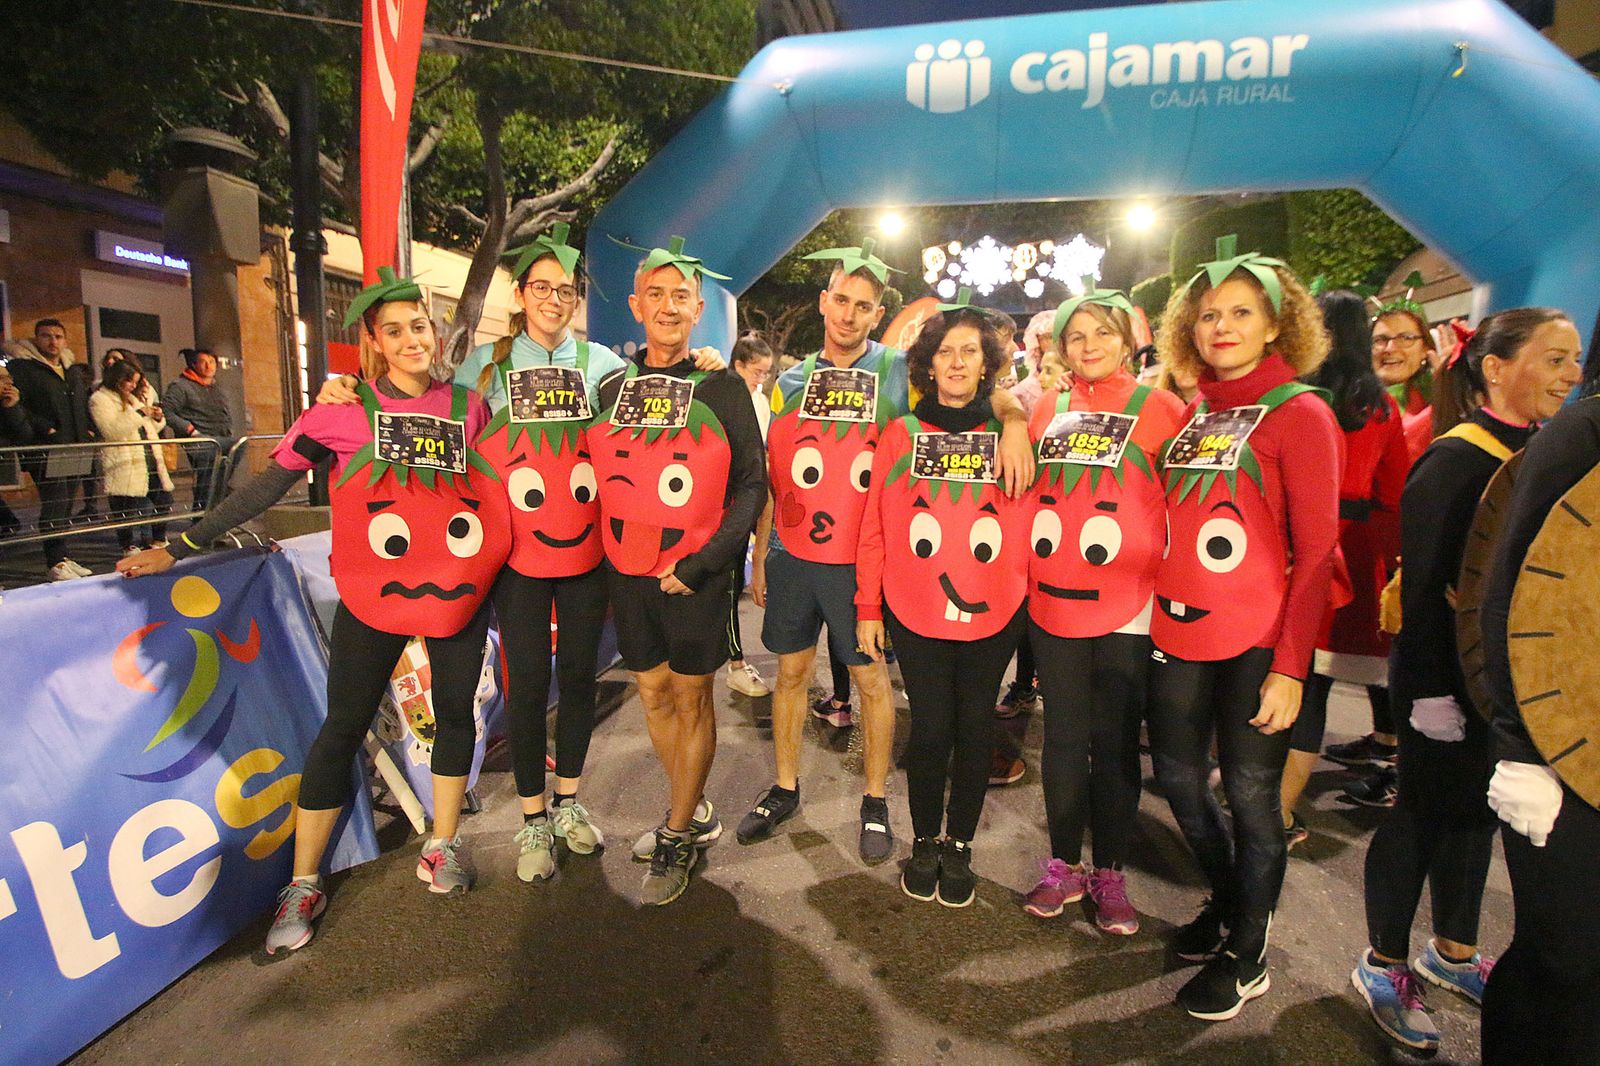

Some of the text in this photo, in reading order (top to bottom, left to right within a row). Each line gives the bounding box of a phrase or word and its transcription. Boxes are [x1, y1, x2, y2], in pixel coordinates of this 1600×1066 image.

[1010, 32, 1309, 109] cajamar
[1150, 82, 1296, 110] CAJA RURAL
[535, 390, 575, 406] 2177
[643, 397, 672, 413] 703
[826, 390, 864, 408] 2175
[412, 437, 445, 455] 701
[1067, 432, 1113, 451] 1852
[1196, 434, 1235, 453] 1846
[940, 453, 982, 469] 1849
[0, 747, 303, 979] tes
